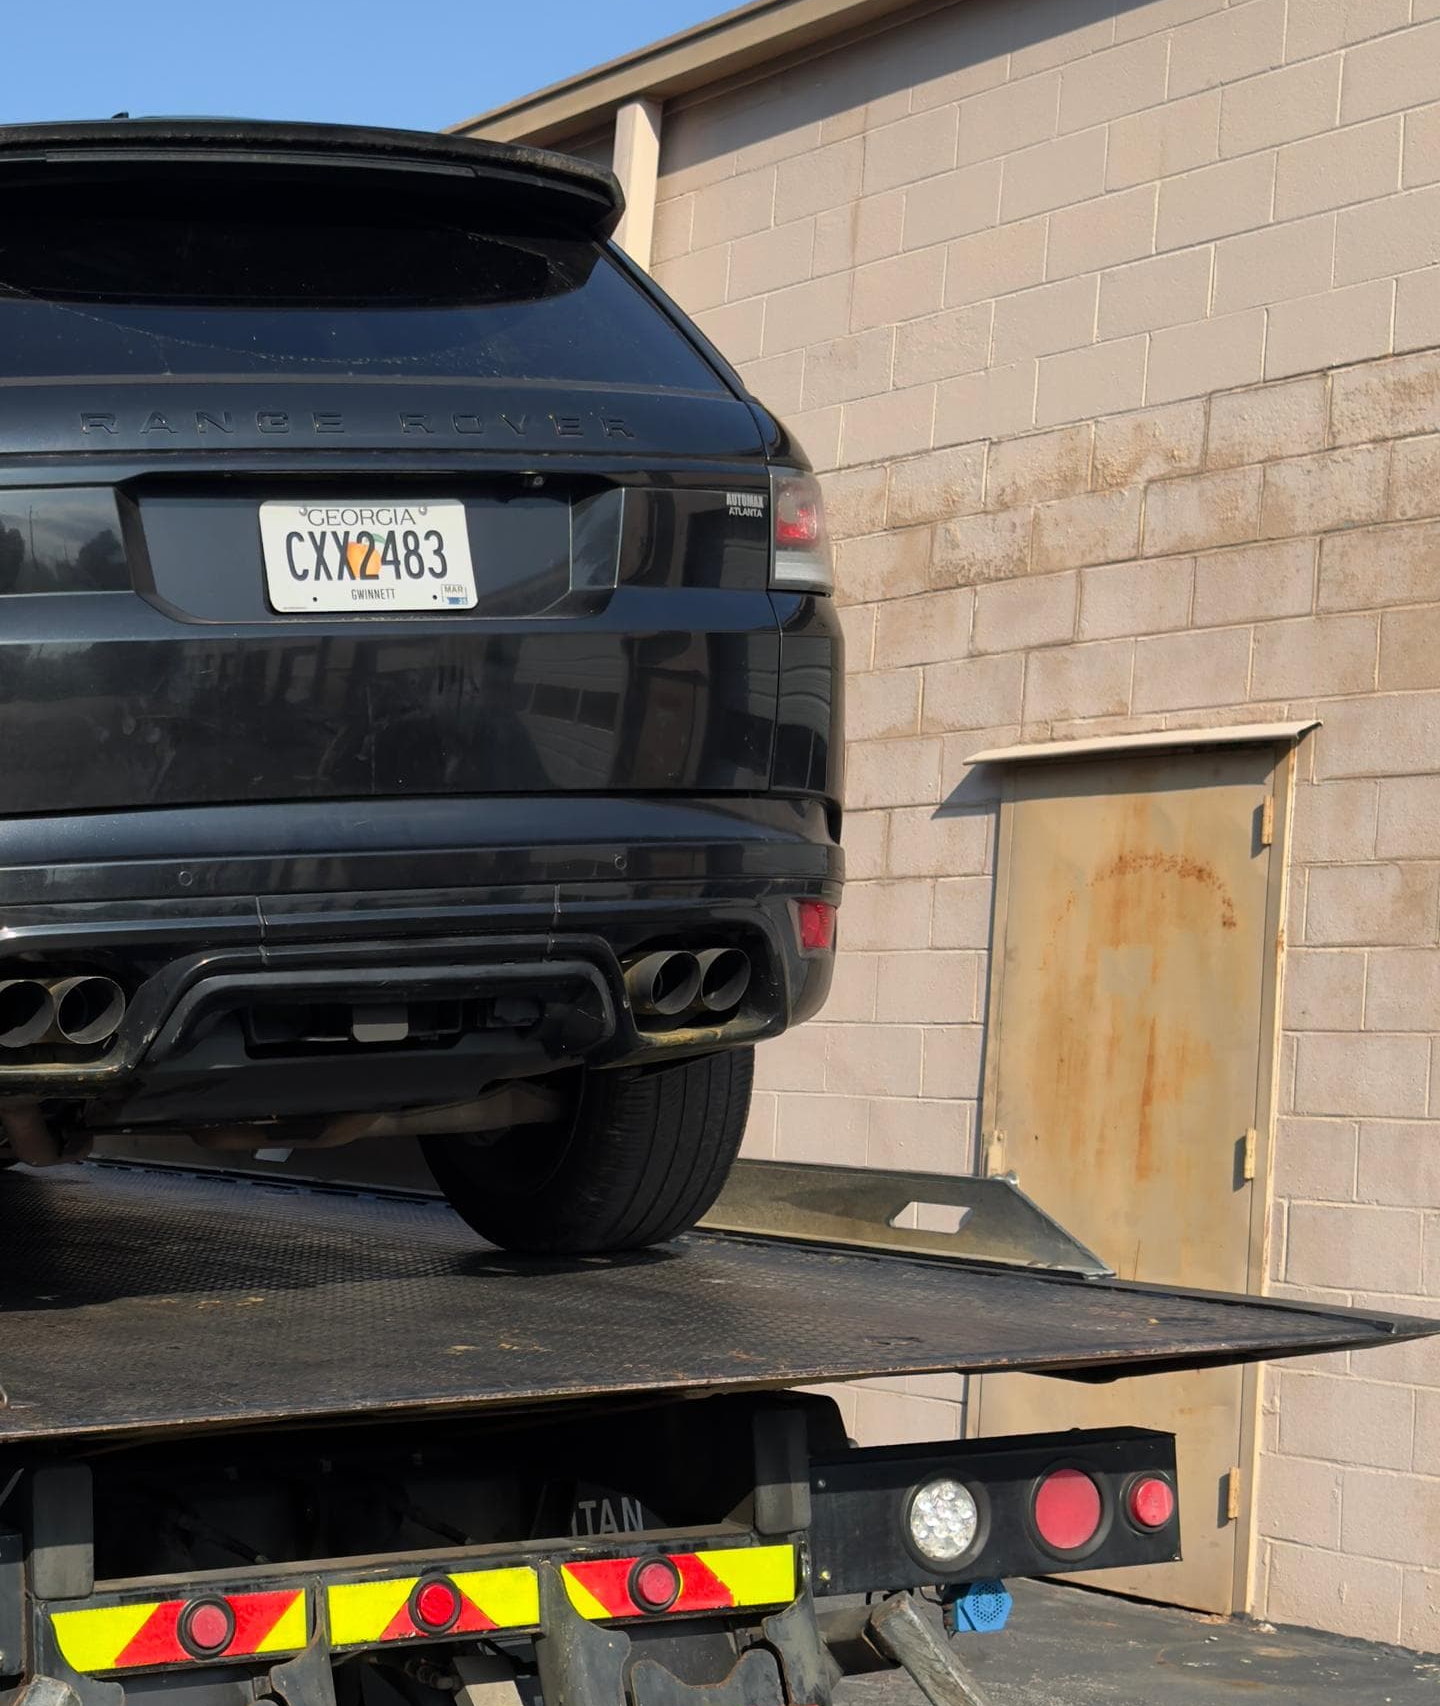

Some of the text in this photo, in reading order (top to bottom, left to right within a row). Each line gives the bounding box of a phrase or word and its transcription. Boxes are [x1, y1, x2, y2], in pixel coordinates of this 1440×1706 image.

[81, 411, 636, 438] RANGE ROVER
[306, 508, 417, 527] GEORGIA
[728, 506, 763, 518] ATLANTA
[285, 529, 448, 582] CXX2483
[350, 588, 397, 601] GWINNETT
